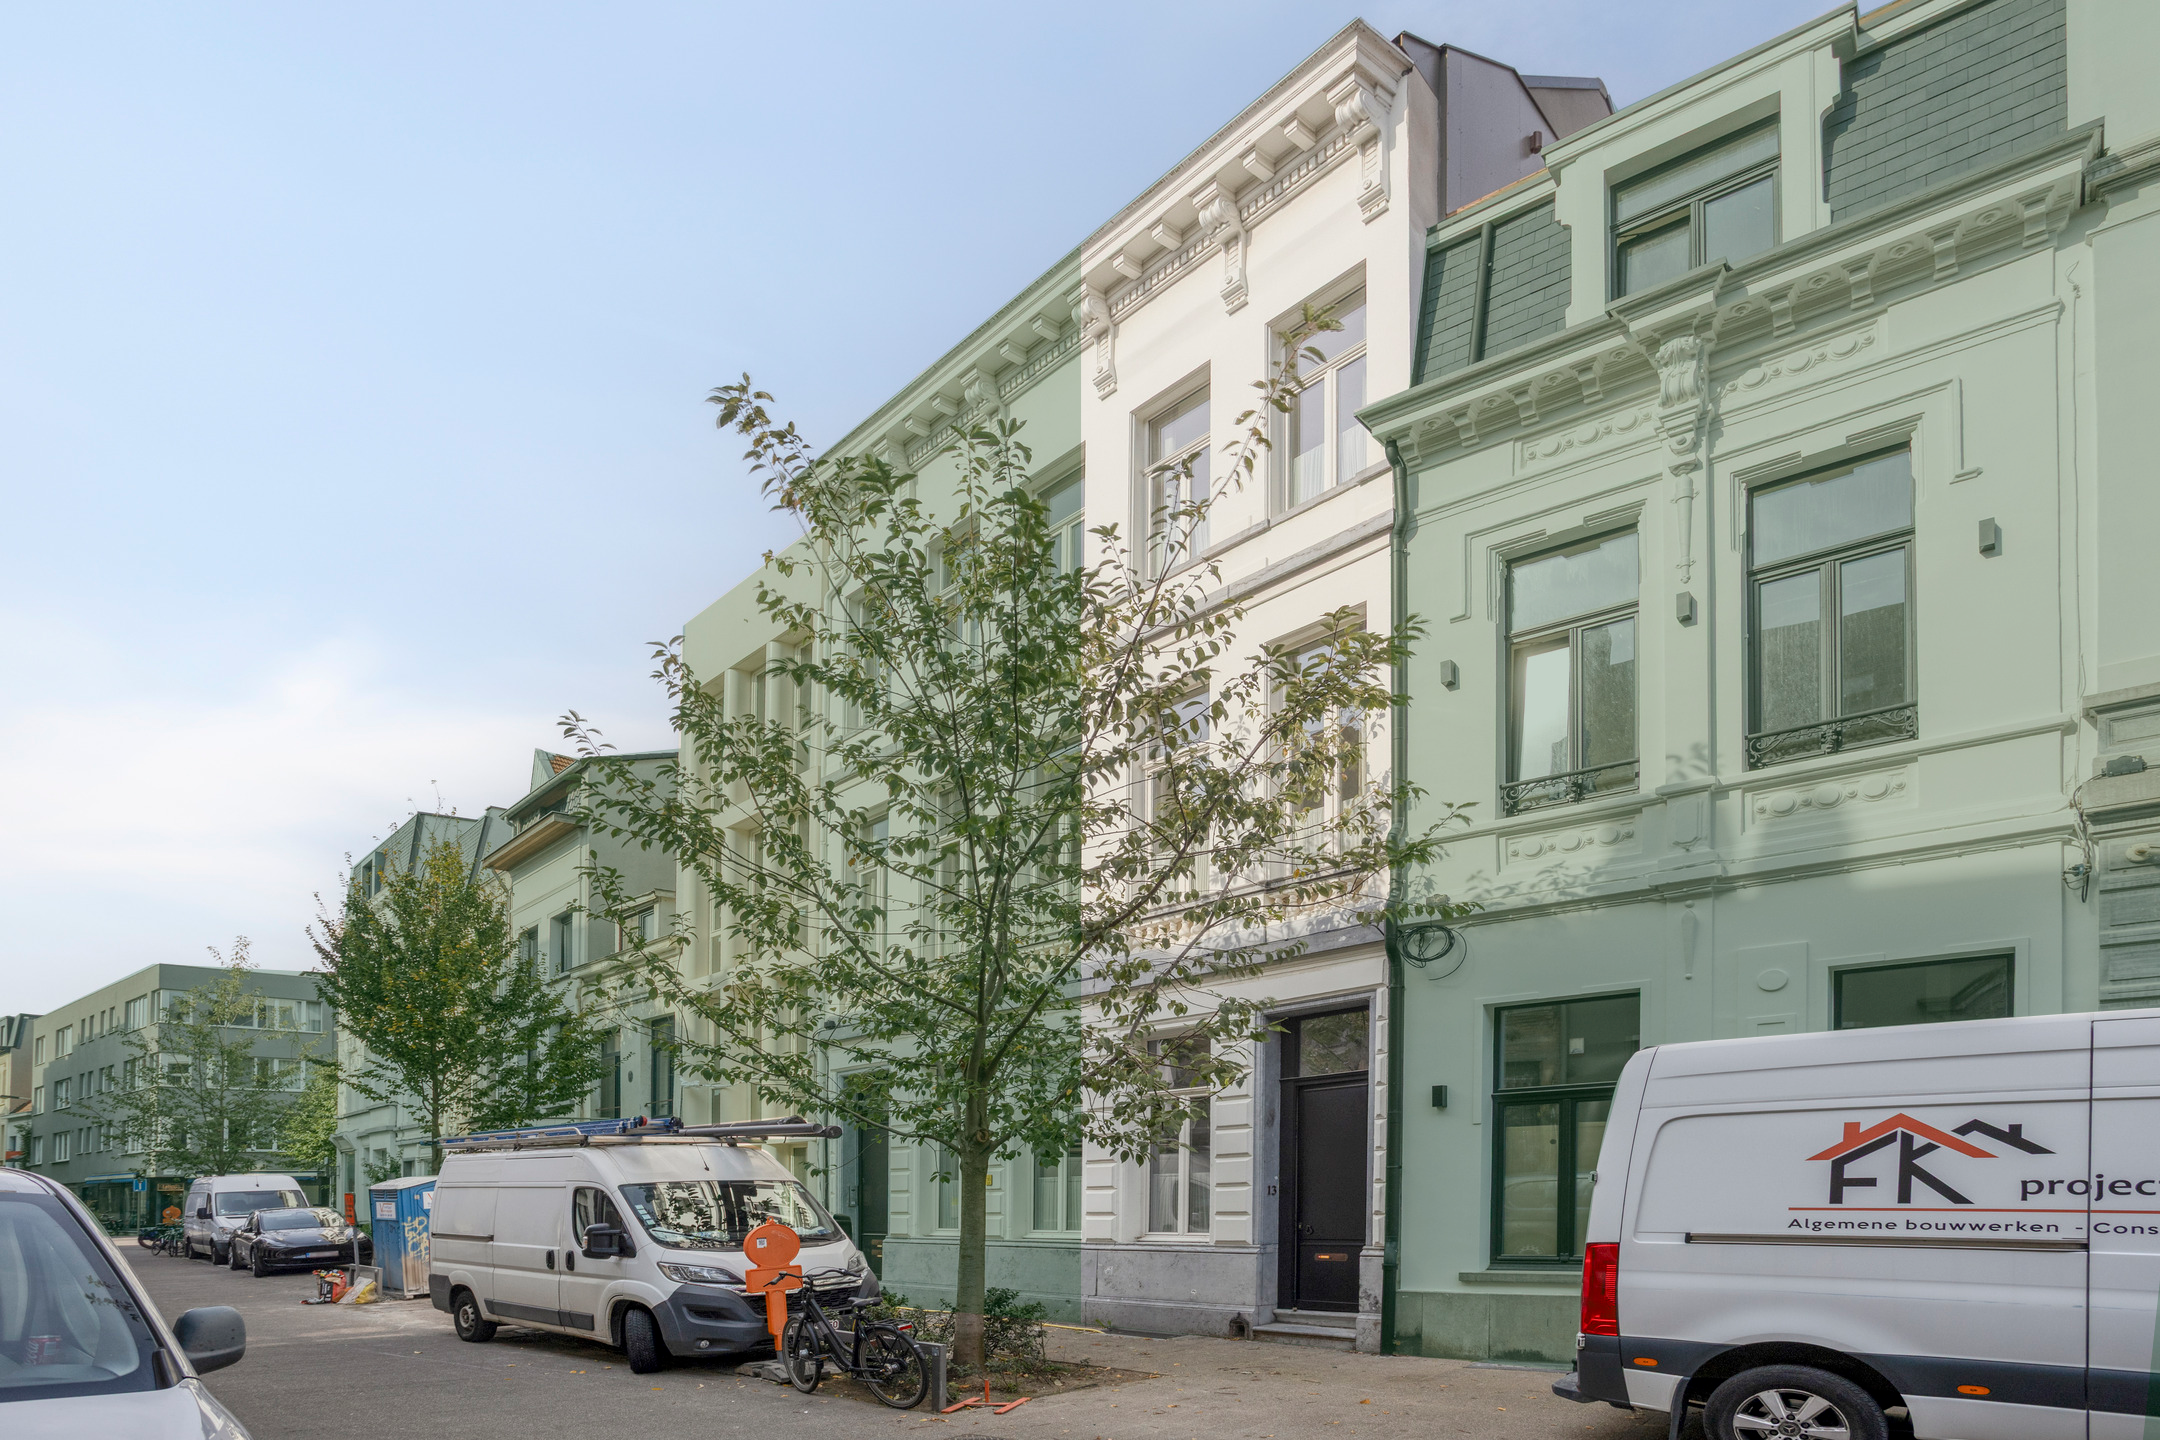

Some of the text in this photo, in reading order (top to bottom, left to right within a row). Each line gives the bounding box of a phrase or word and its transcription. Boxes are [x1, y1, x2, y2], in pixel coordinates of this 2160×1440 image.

[1829, 1130, 1975, 1204] FK
[1267, 1185, 1277, 1196] 13
[2020, 1174, 2160, 1201] projec
[1788, 1218, 1897, 1232] Algemene
[1905, 1219, 2059, 1233] bouwwerken
[2093, 1222, 2159, 1235] Cons
